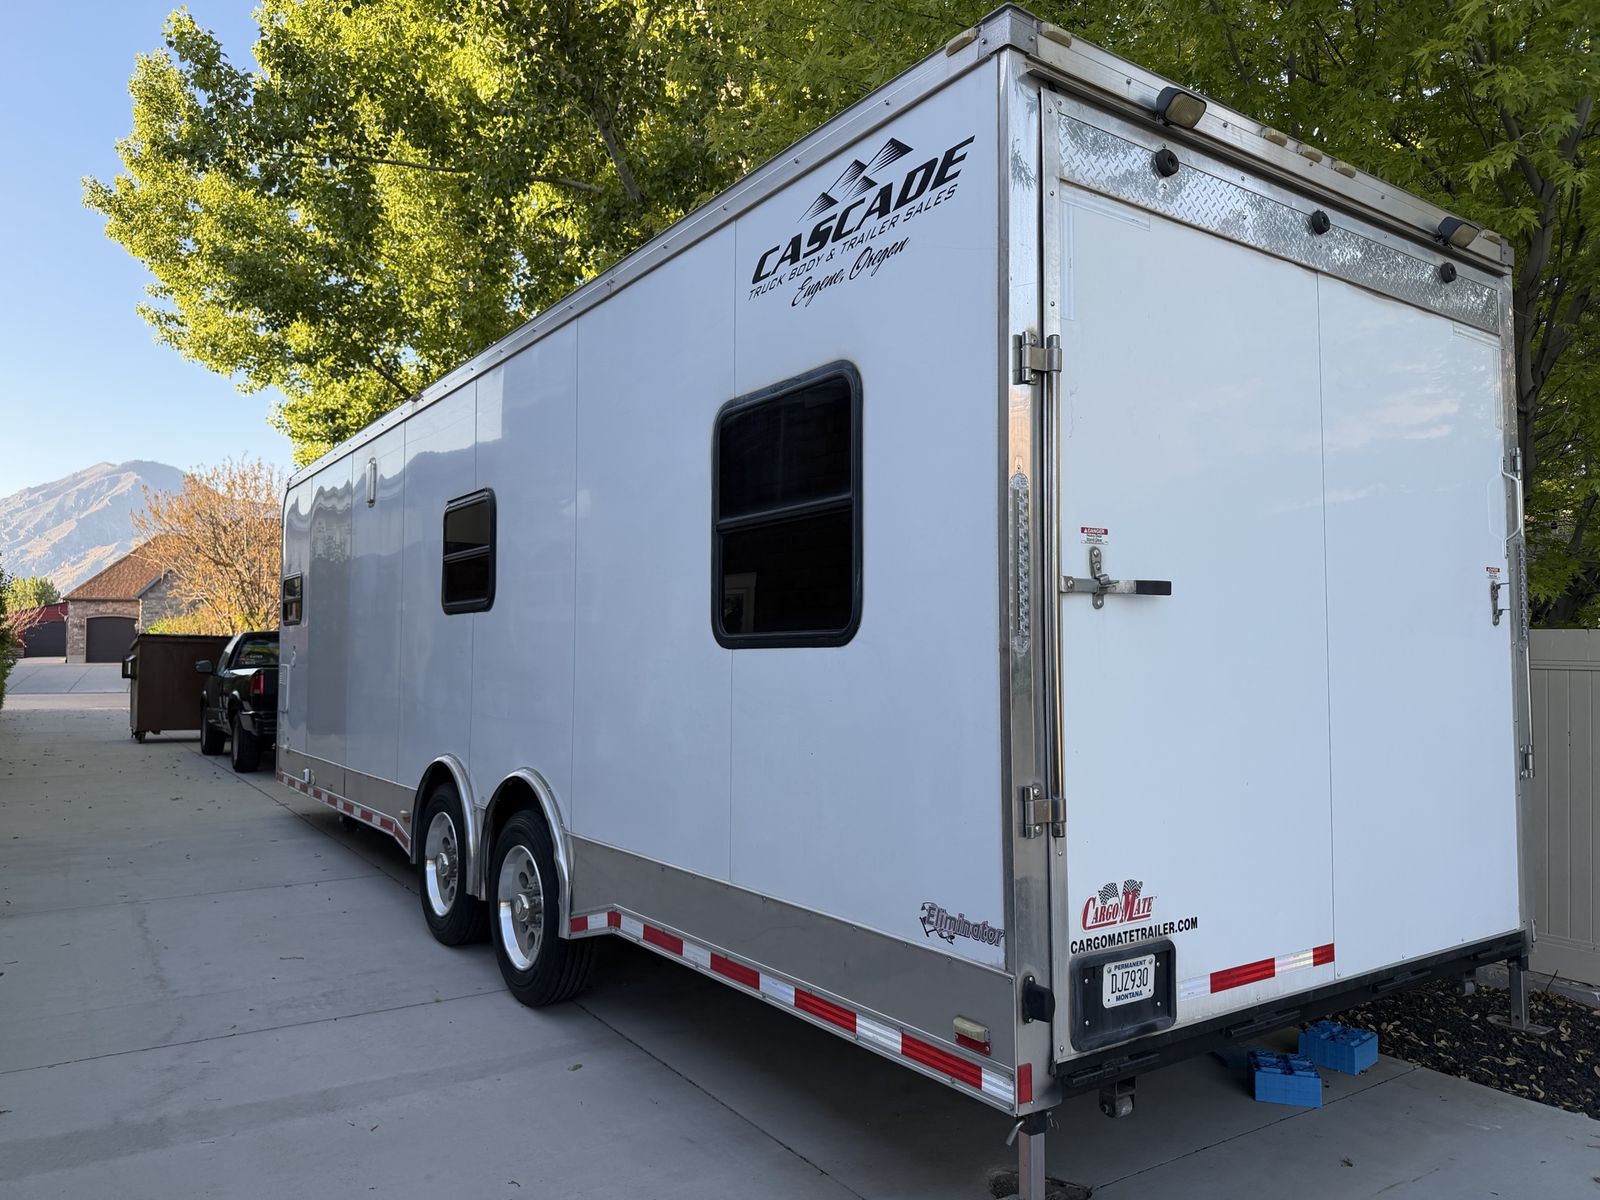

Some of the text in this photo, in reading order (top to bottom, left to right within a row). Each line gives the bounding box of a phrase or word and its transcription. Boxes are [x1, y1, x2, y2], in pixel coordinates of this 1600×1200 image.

[751, 135, 976, 285] CASCADE
[749, 183, 958, 301] TRUCK BODY & TRAILER SALES
[791, 236, 911, 308] Eugene, Oregon
[926, 906, 1005, 947] Eliminator
[1070, 916, 1198, 955] CARGOMATETRAILER.COM
[1111, 967, 1149, 994] DJZ930
[1113, 959, 1147, 971] PERMANENT
[1115, 990, 1143, 1002] MONTANA
